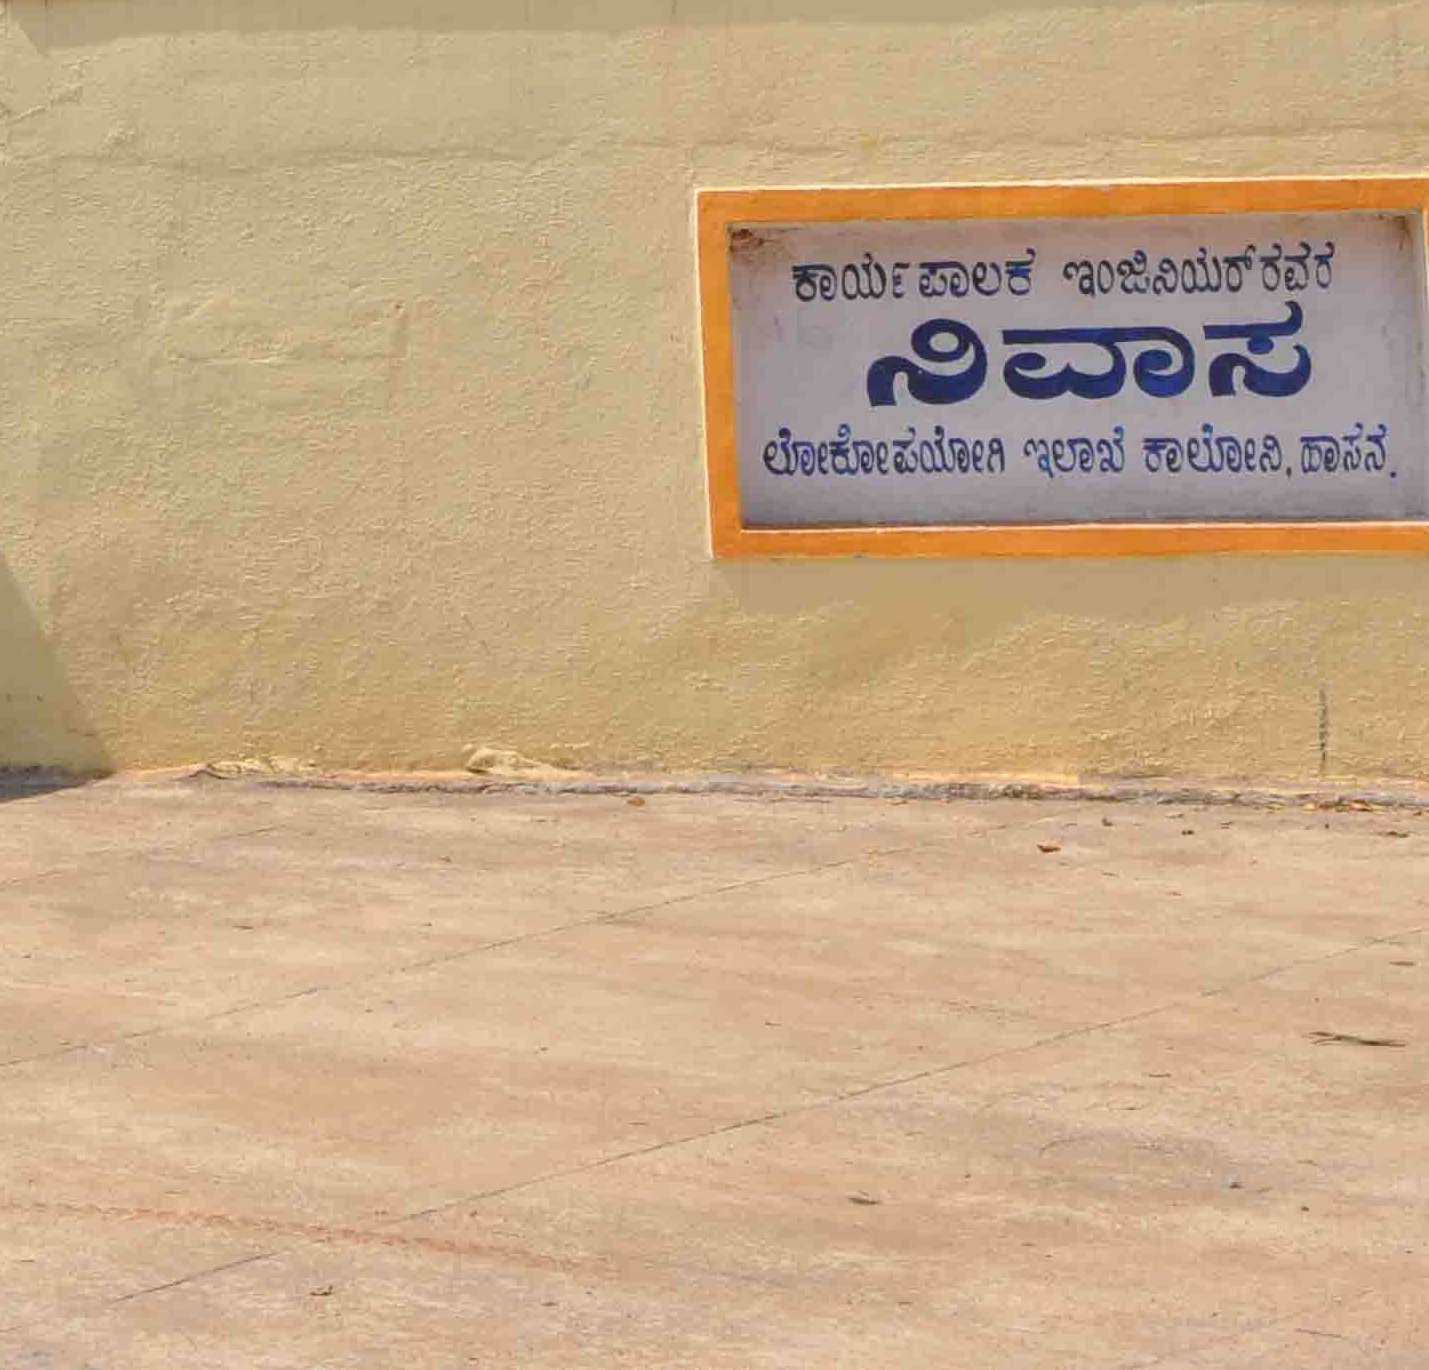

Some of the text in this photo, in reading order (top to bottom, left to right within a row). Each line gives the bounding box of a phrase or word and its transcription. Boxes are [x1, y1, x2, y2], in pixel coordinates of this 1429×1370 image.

[866, 301, 1312, 407] ನಿವಾಸ
[763, 424, 1006, 476] ಲೋಕೋಪಯೋಗಿ
[1023, 425, 1126, 478] ಇಲಾಖೆ
